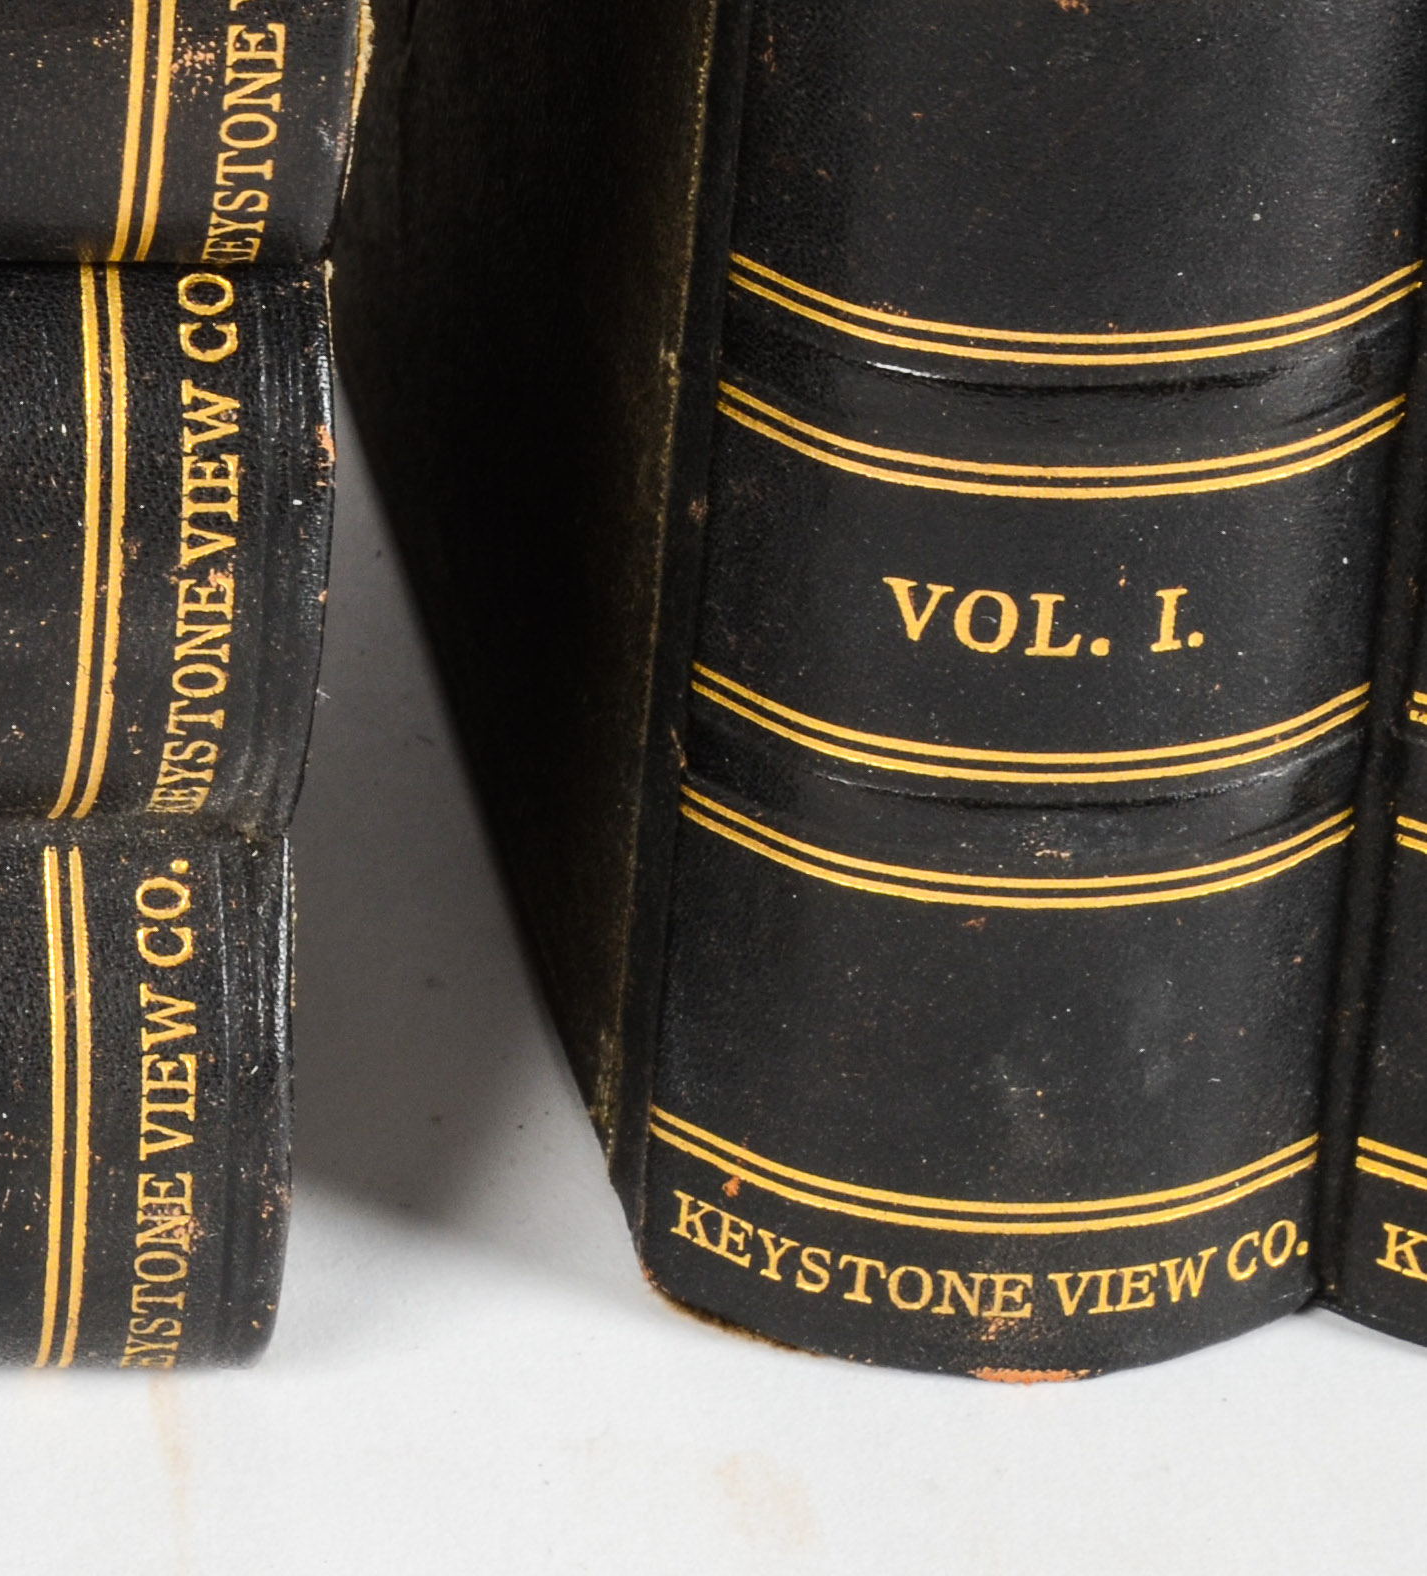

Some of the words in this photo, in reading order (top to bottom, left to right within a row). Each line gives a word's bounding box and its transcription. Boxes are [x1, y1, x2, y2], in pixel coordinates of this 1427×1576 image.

[179, 379, 241, 564] VIEW
[881, 576, 1112, 659] VOL.
[1149, 586, 1207, 654] I.
[135, 858, 196, 968] CO.
[139, 982, 198, 1162] VIEW
[118, 1170, 196, 1369] EYSTONE
[669, 1190, 1035, 1320] KEYSTONE
[1046, 1246, 1215, 1318] VIEW
[1225, 1217, 1311, 1284] CO.
